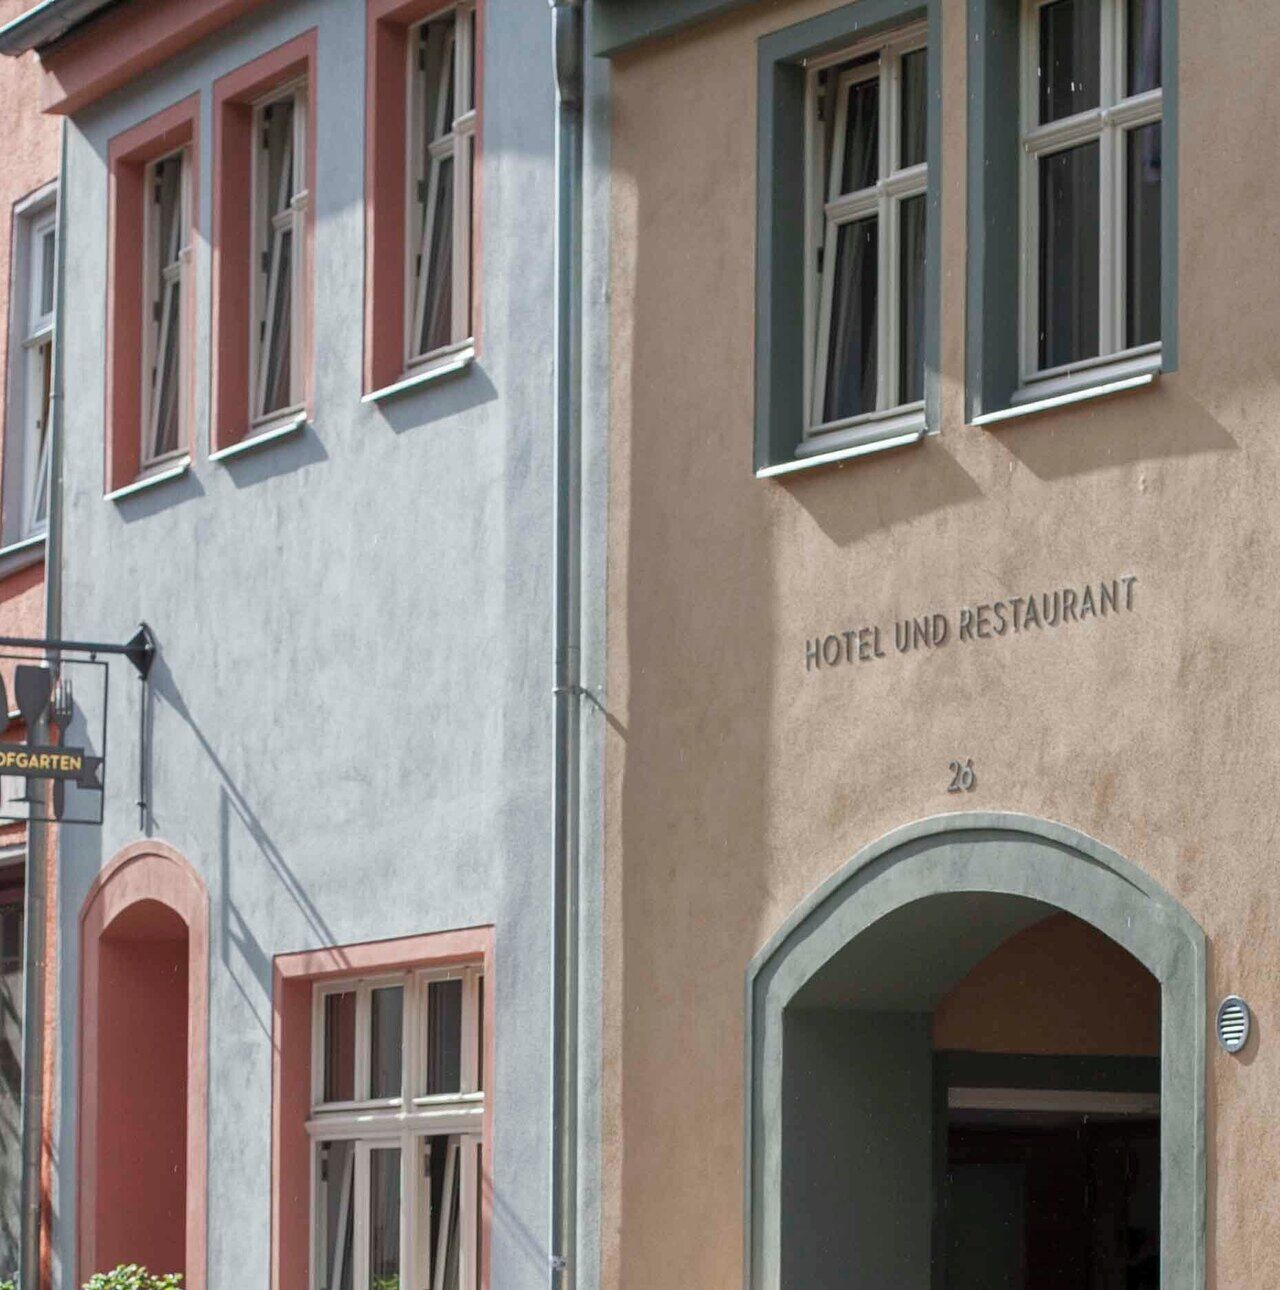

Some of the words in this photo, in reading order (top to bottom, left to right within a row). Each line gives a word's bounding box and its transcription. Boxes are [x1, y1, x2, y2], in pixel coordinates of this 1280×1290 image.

[805, 625, 886, 672] HOTEL
[895, 613, 949, 654] UND
[959, 574, 1139, 642] RESTAURANT
[947, 758, 977, 794] 26
